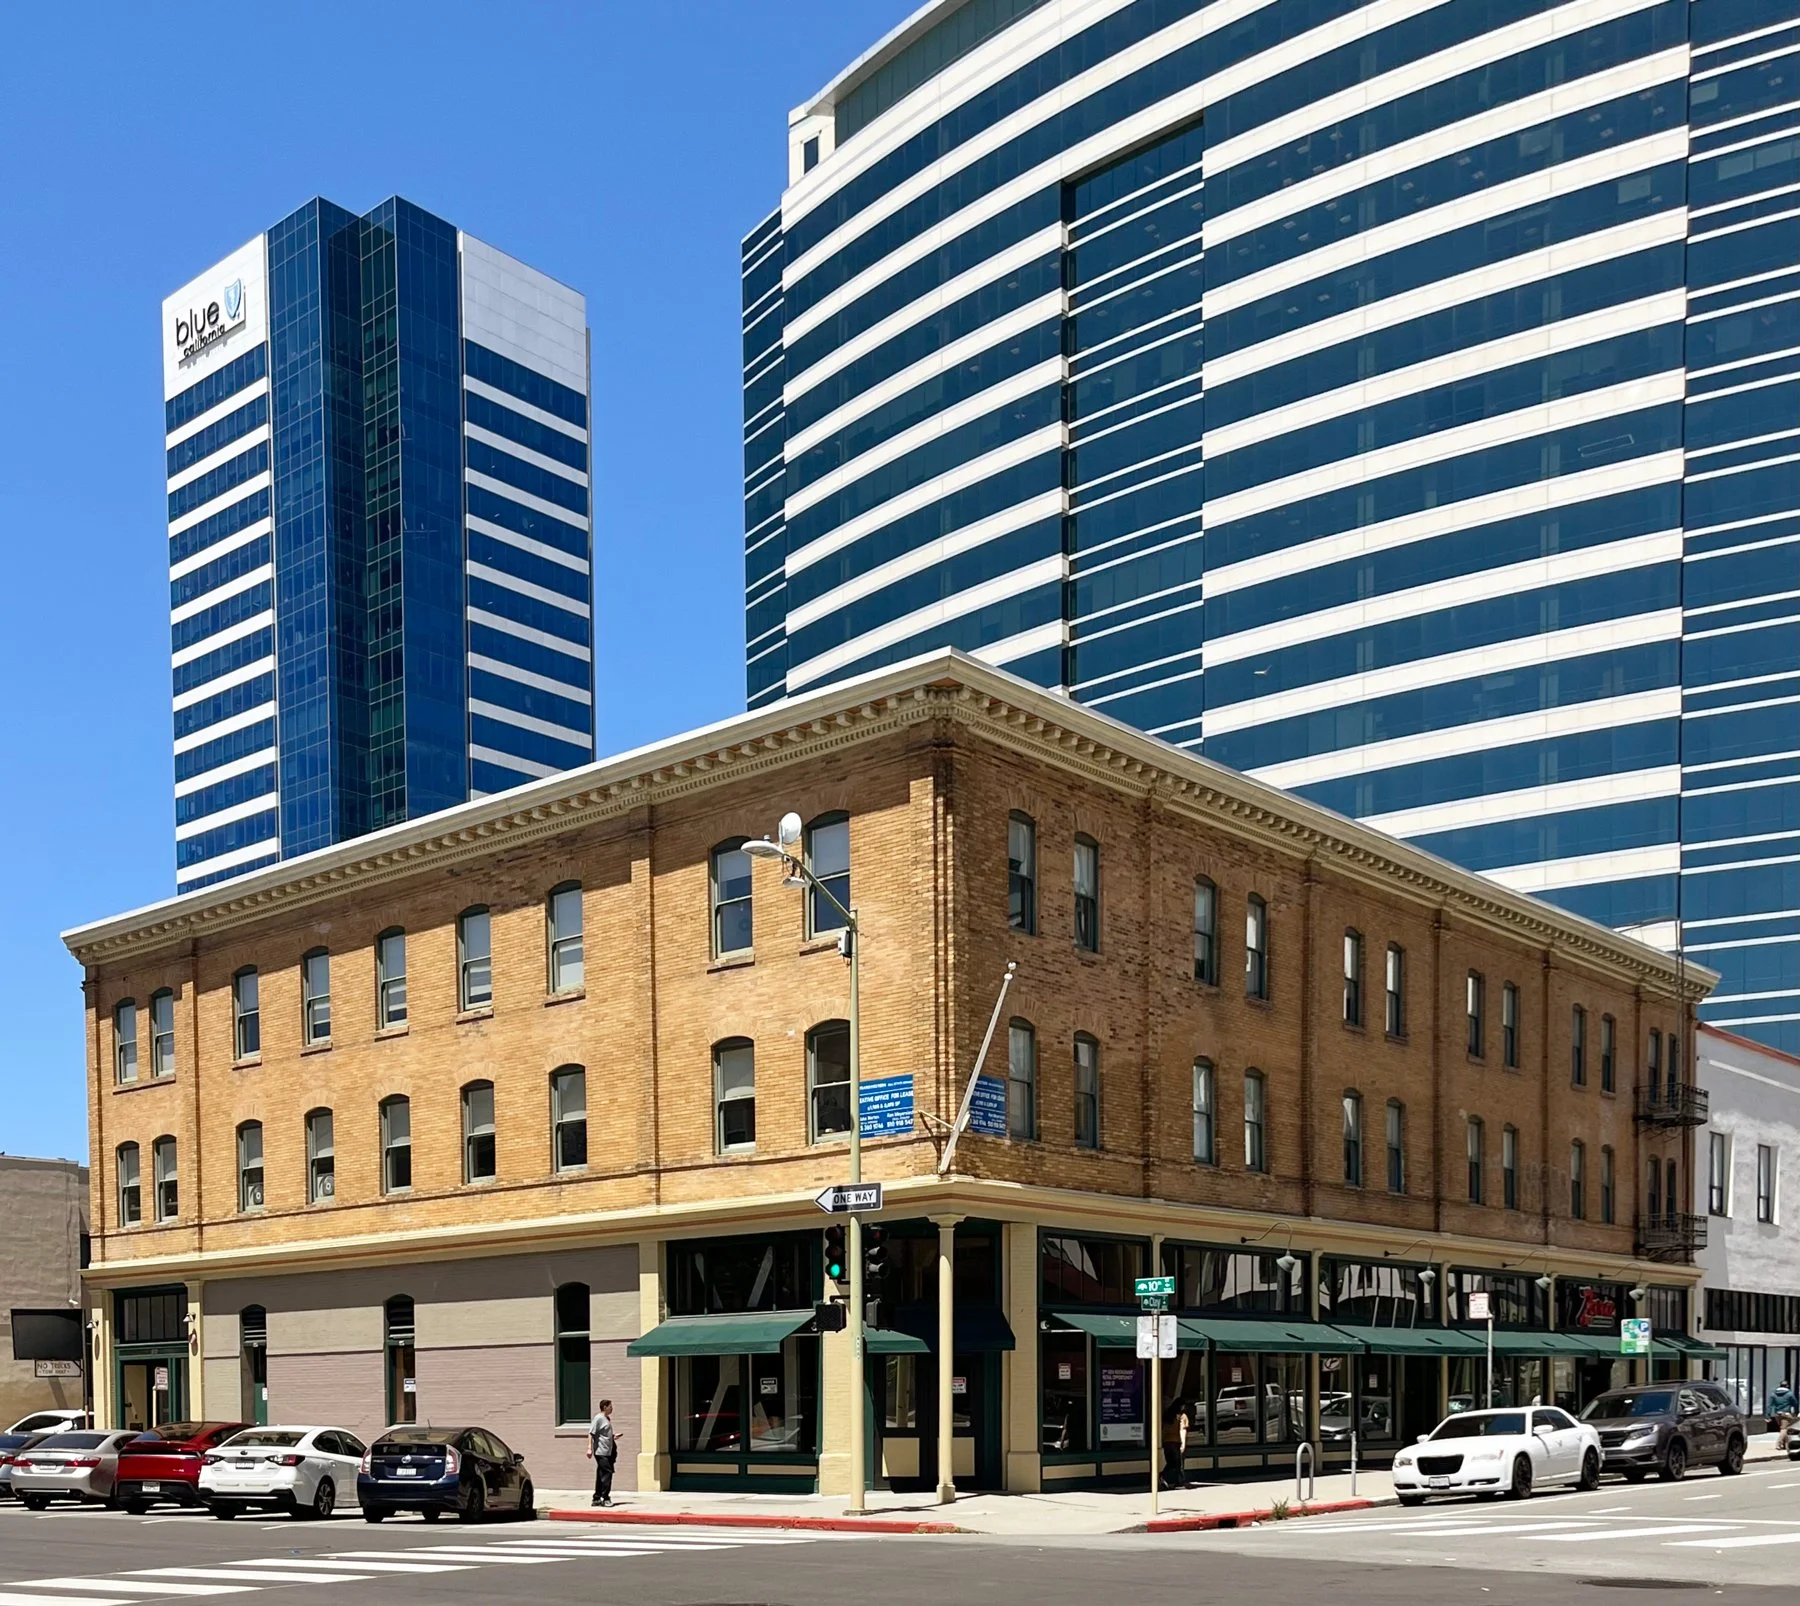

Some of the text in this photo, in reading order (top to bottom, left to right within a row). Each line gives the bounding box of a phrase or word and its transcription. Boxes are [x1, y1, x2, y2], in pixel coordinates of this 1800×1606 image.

[175, 301, 220, 346] blue
[183, 323, 225, 357] california
[890, 1092, 900, 1100] FOR
[833, 1191, 874, 1204] ONE WAY
[37, 1361, 48, 1370] NO
